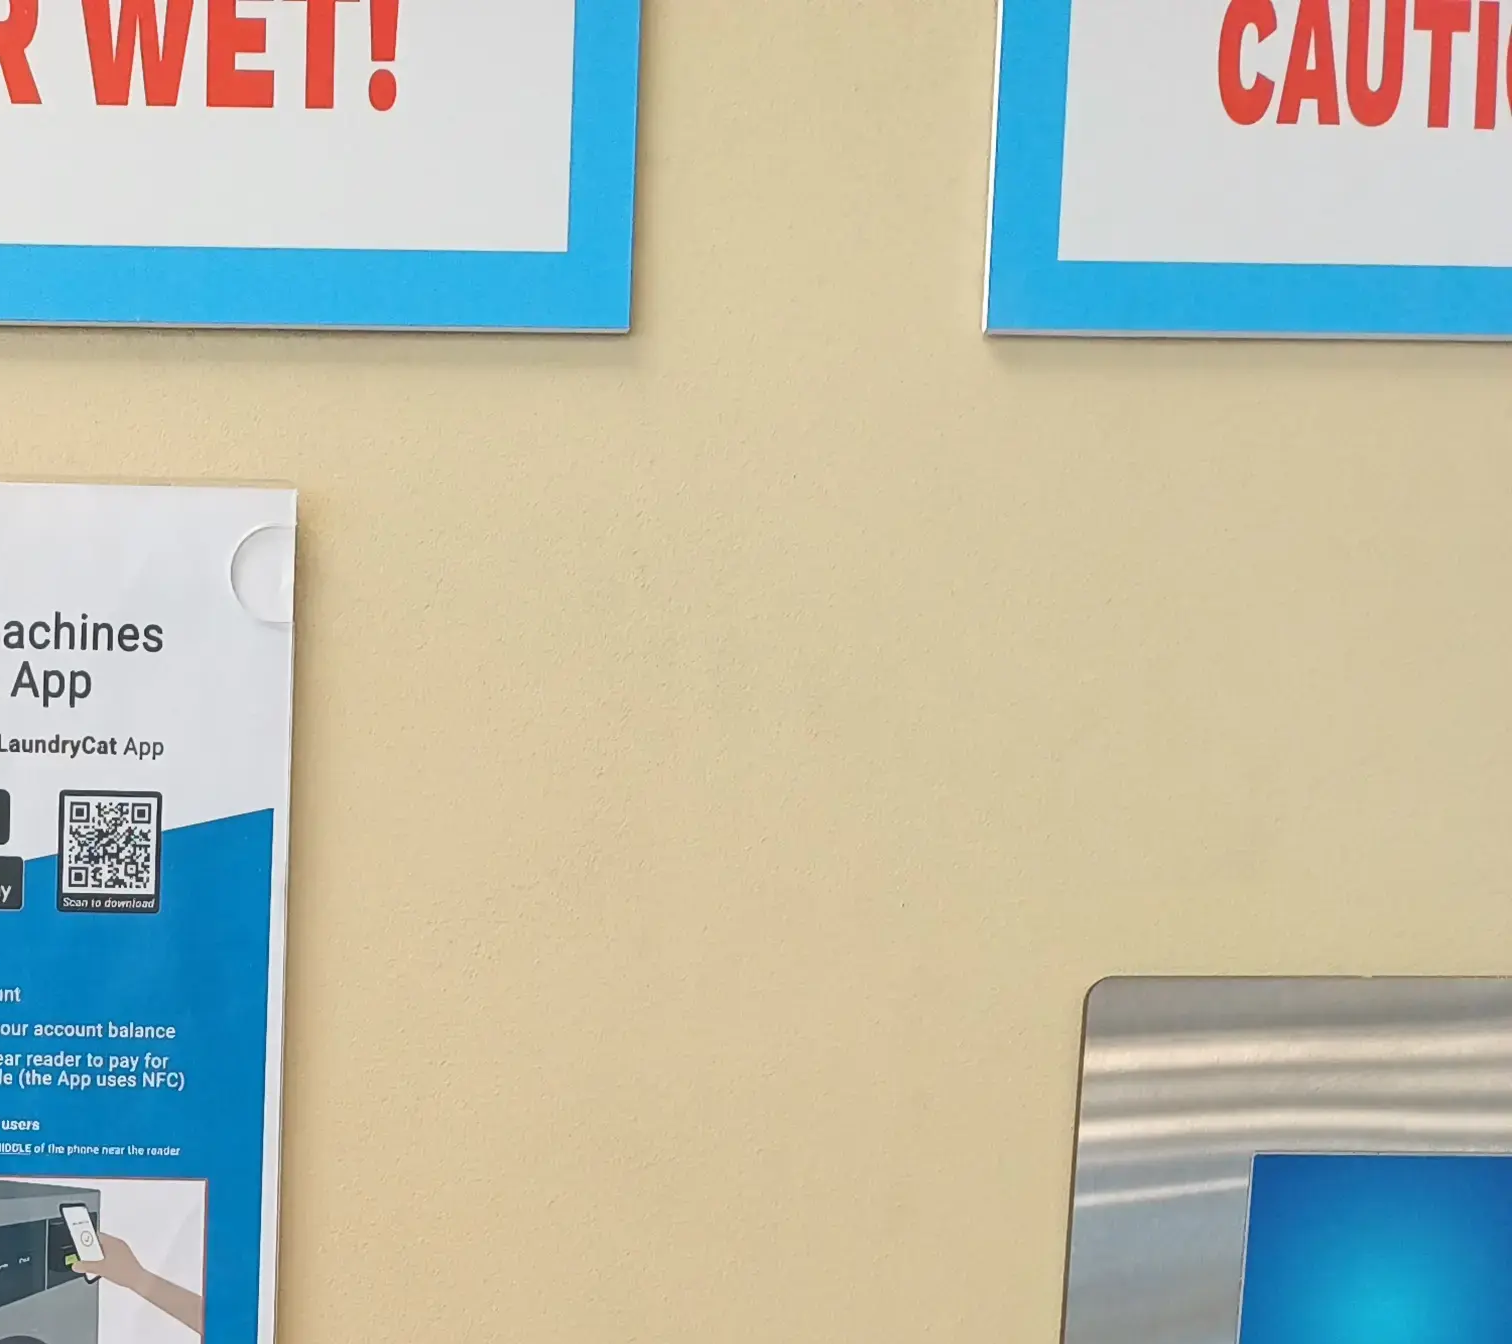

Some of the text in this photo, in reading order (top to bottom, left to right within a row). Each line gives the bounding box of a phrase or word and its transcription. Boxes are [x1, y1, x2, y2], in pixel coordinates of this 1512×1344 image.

[85, 0, 400, 112] WET!
[1218, 0, 1512, 130] CAUTI
[10, 661, 92, 708] App
[123, 736, 165, 760] App
[62, 897, 155, 909] Scan to download
[34, 1021, 103, 1038] account
[108, 1022, 176, 1039] balance
[26, 1052, 82, 1068] reader
[87, 1054, 103, 1069] to
[108, 1056, 138, 1072] pay
[144, 1053, 169, 1070] for
[18, 1070, 52, 1089] (the
[57, 1070, 92, 1090] App
[96, 1074, 137, 1088] uses
[142, 1072, 185, 1092] NFC)
[1, 1118, 40, 1131] users
[34, 1143, 45, 1153] of
[48, 1143, 64, 1154] the
[67, 1144, 99, 1156] phone
[102, 1145, 125, 1156] near
[127, 1145, 144, 1156] the
[147, 1146, 180, 1156] reader
